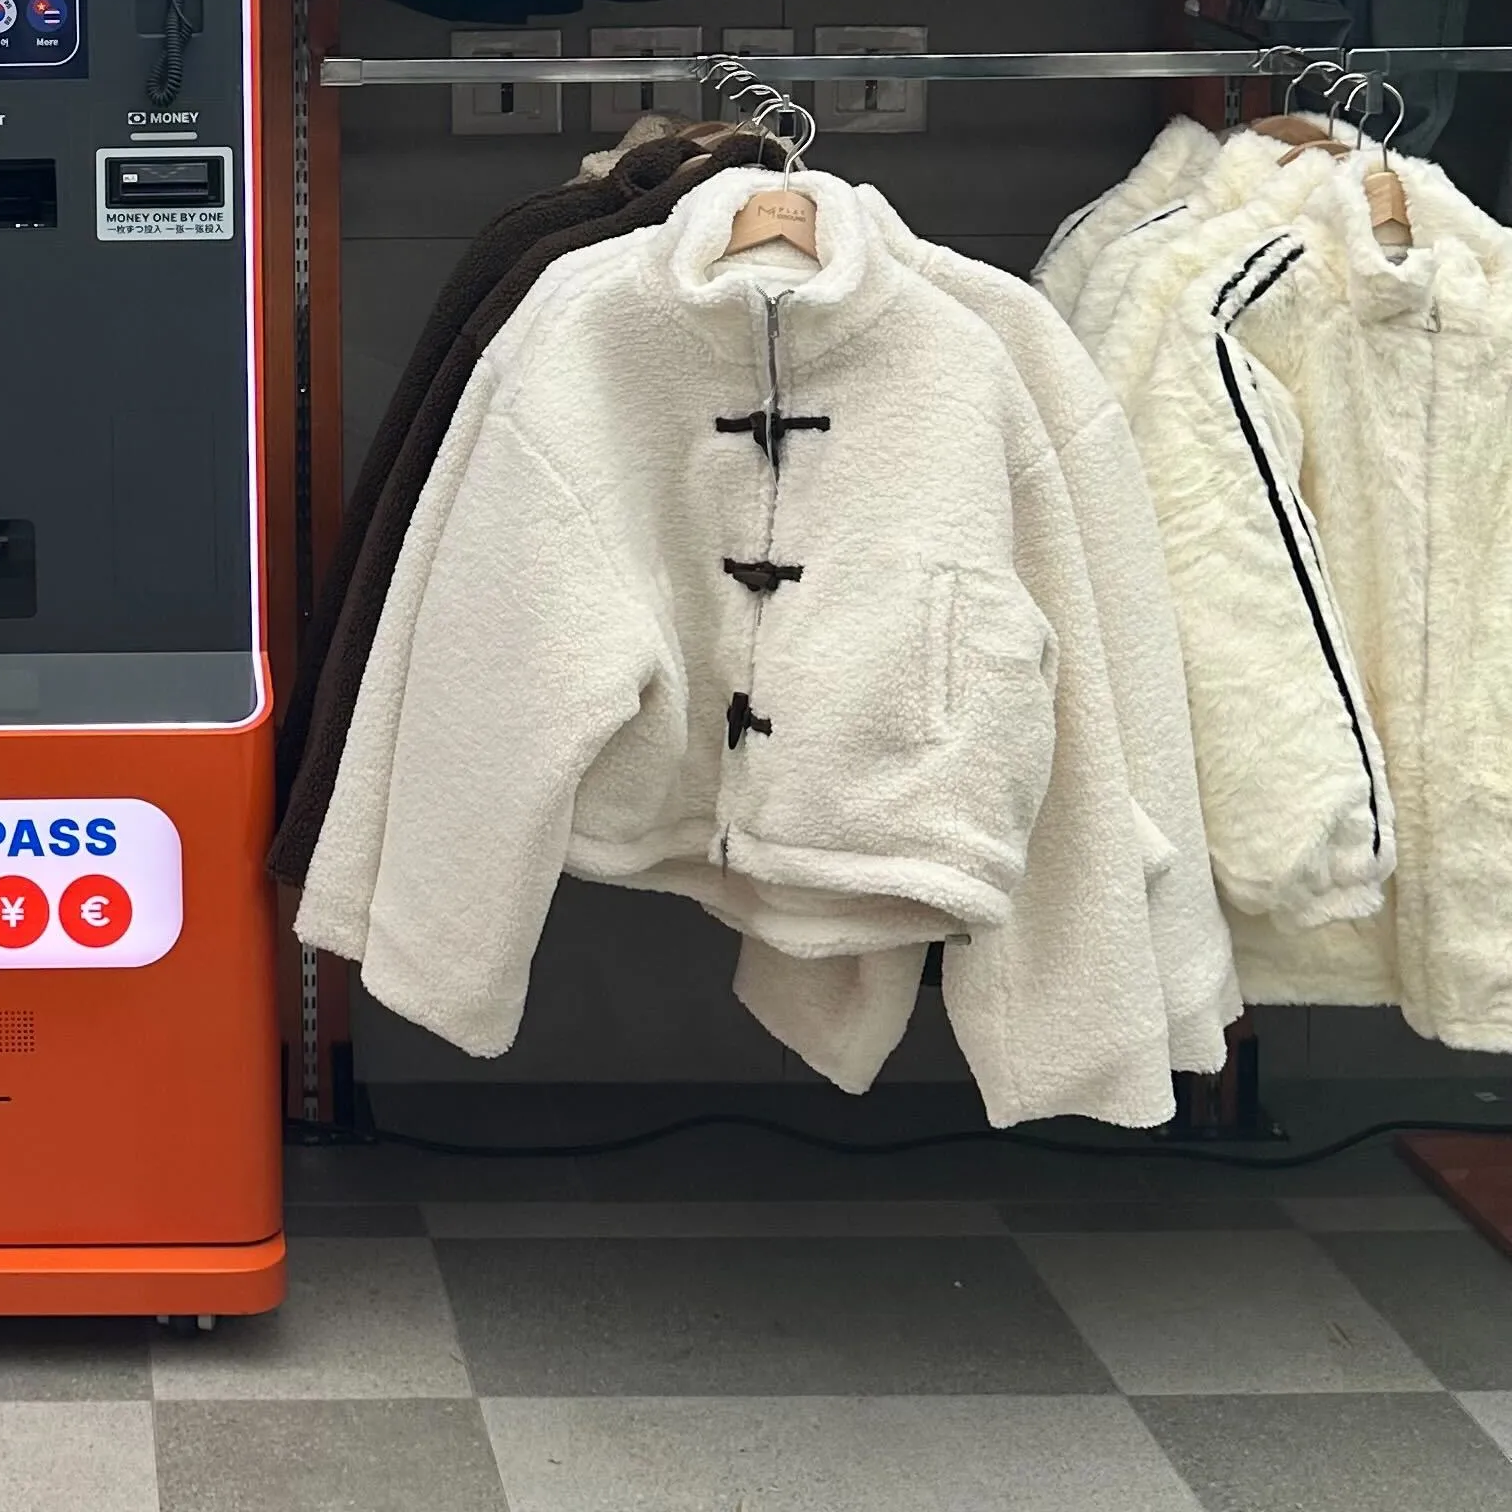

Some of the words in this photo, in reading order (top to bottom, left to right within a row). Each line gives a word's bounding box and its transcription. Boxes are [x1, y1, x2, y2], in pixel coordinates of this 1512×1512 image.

[36, 37, 59, 47] More
[150, 112, 199, 124] MONEY
[106, 213, 150, 223] MONEY
[152, 213, 177, 223] ONE
[180, 212, 197, 222] BY
[199, 212, 224, 222] ONE
